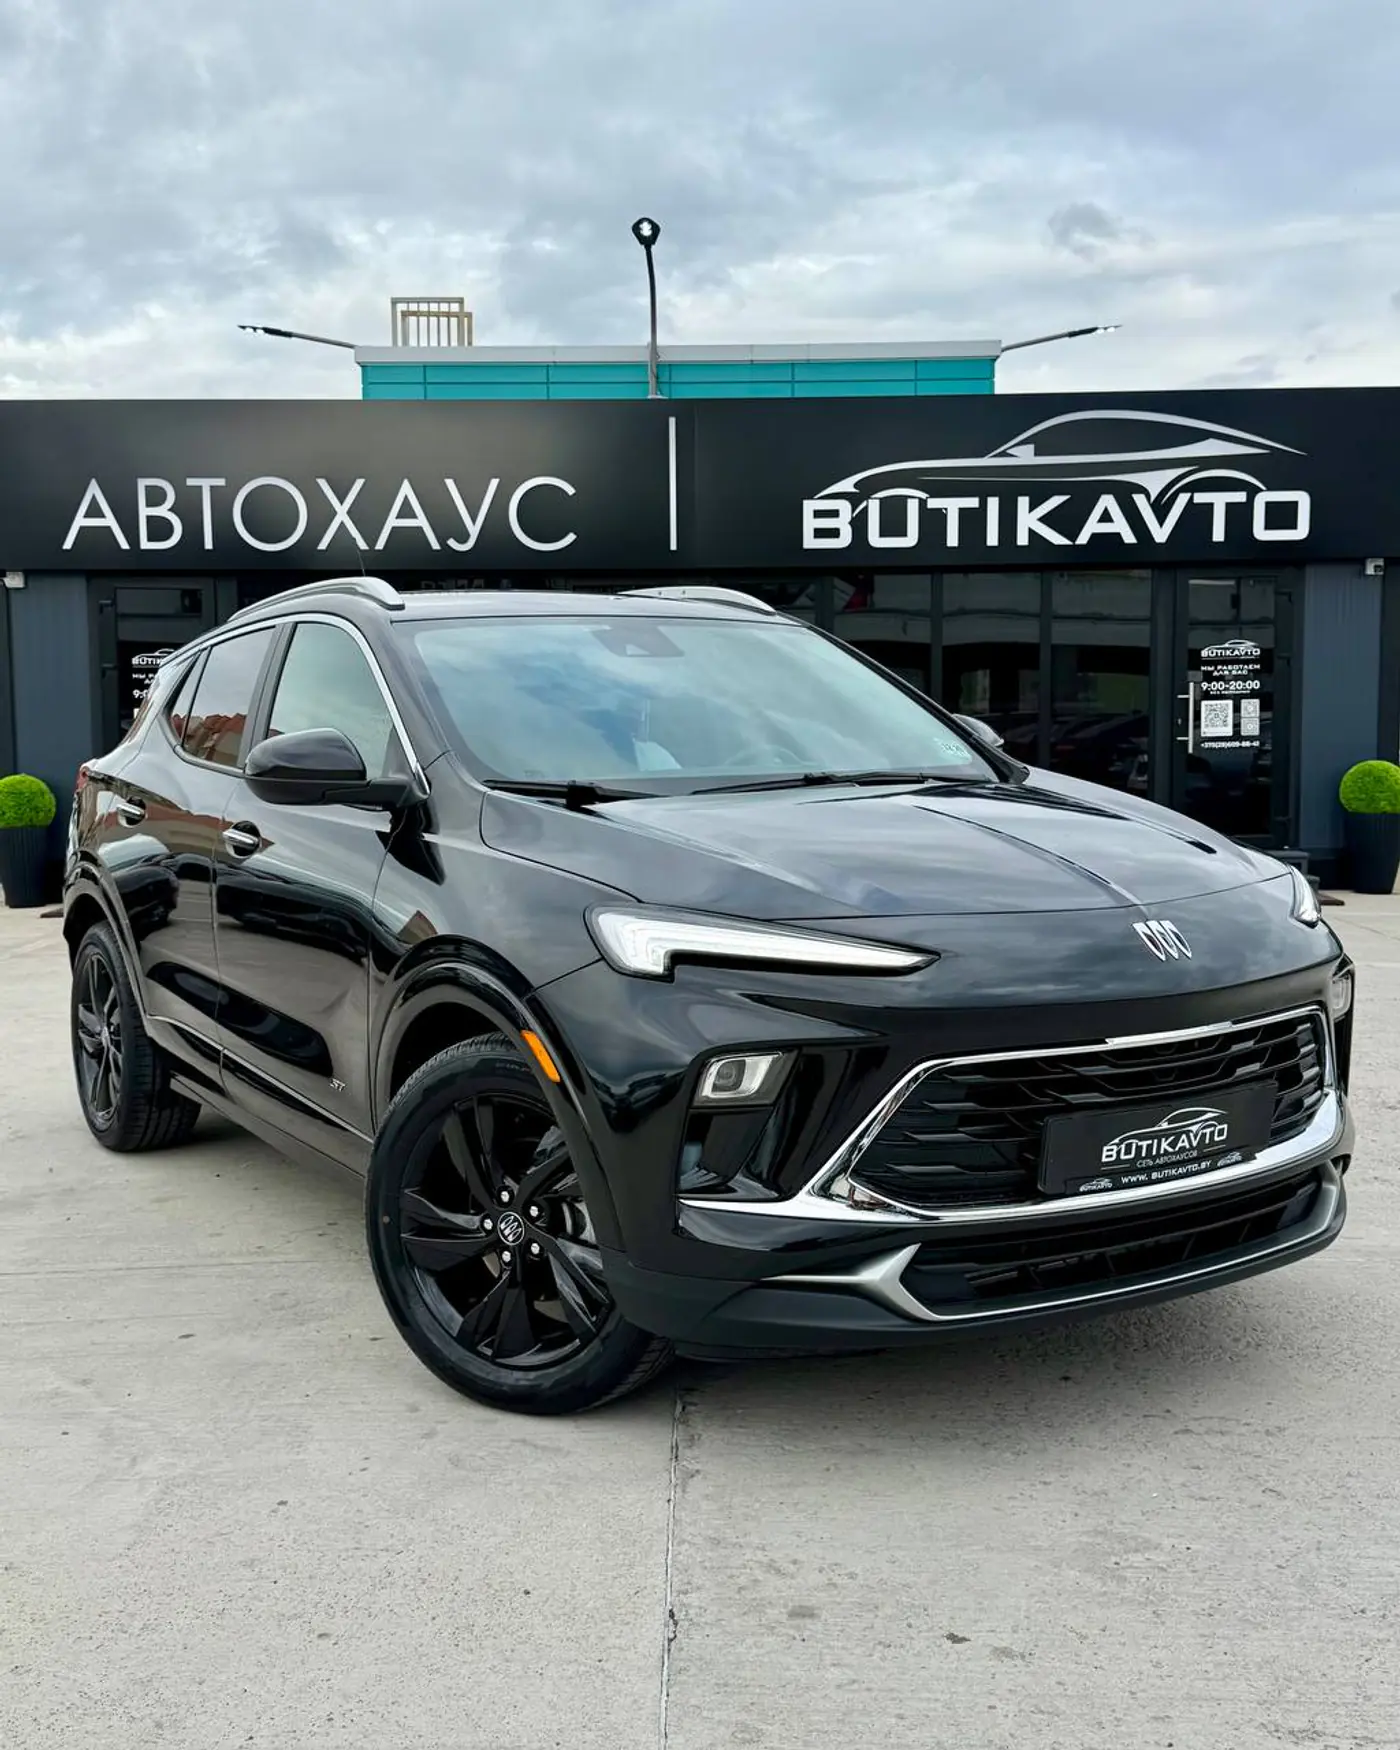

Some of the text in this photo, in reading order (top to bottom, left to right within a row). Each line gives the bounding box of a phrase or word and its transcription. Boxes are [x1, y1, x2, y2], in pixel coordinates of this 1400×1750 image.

[62, 476, 577, 553] АВТОХАУС
[802, 489, 1310, 549] BUTIKAVTO
[1200, 648, 1260, 658] BUTIKAVTO
[1201, 680, 1260, 691] 9:00-20:00
[1101, 1124, 1228, 1163] BUTIKAVTO
